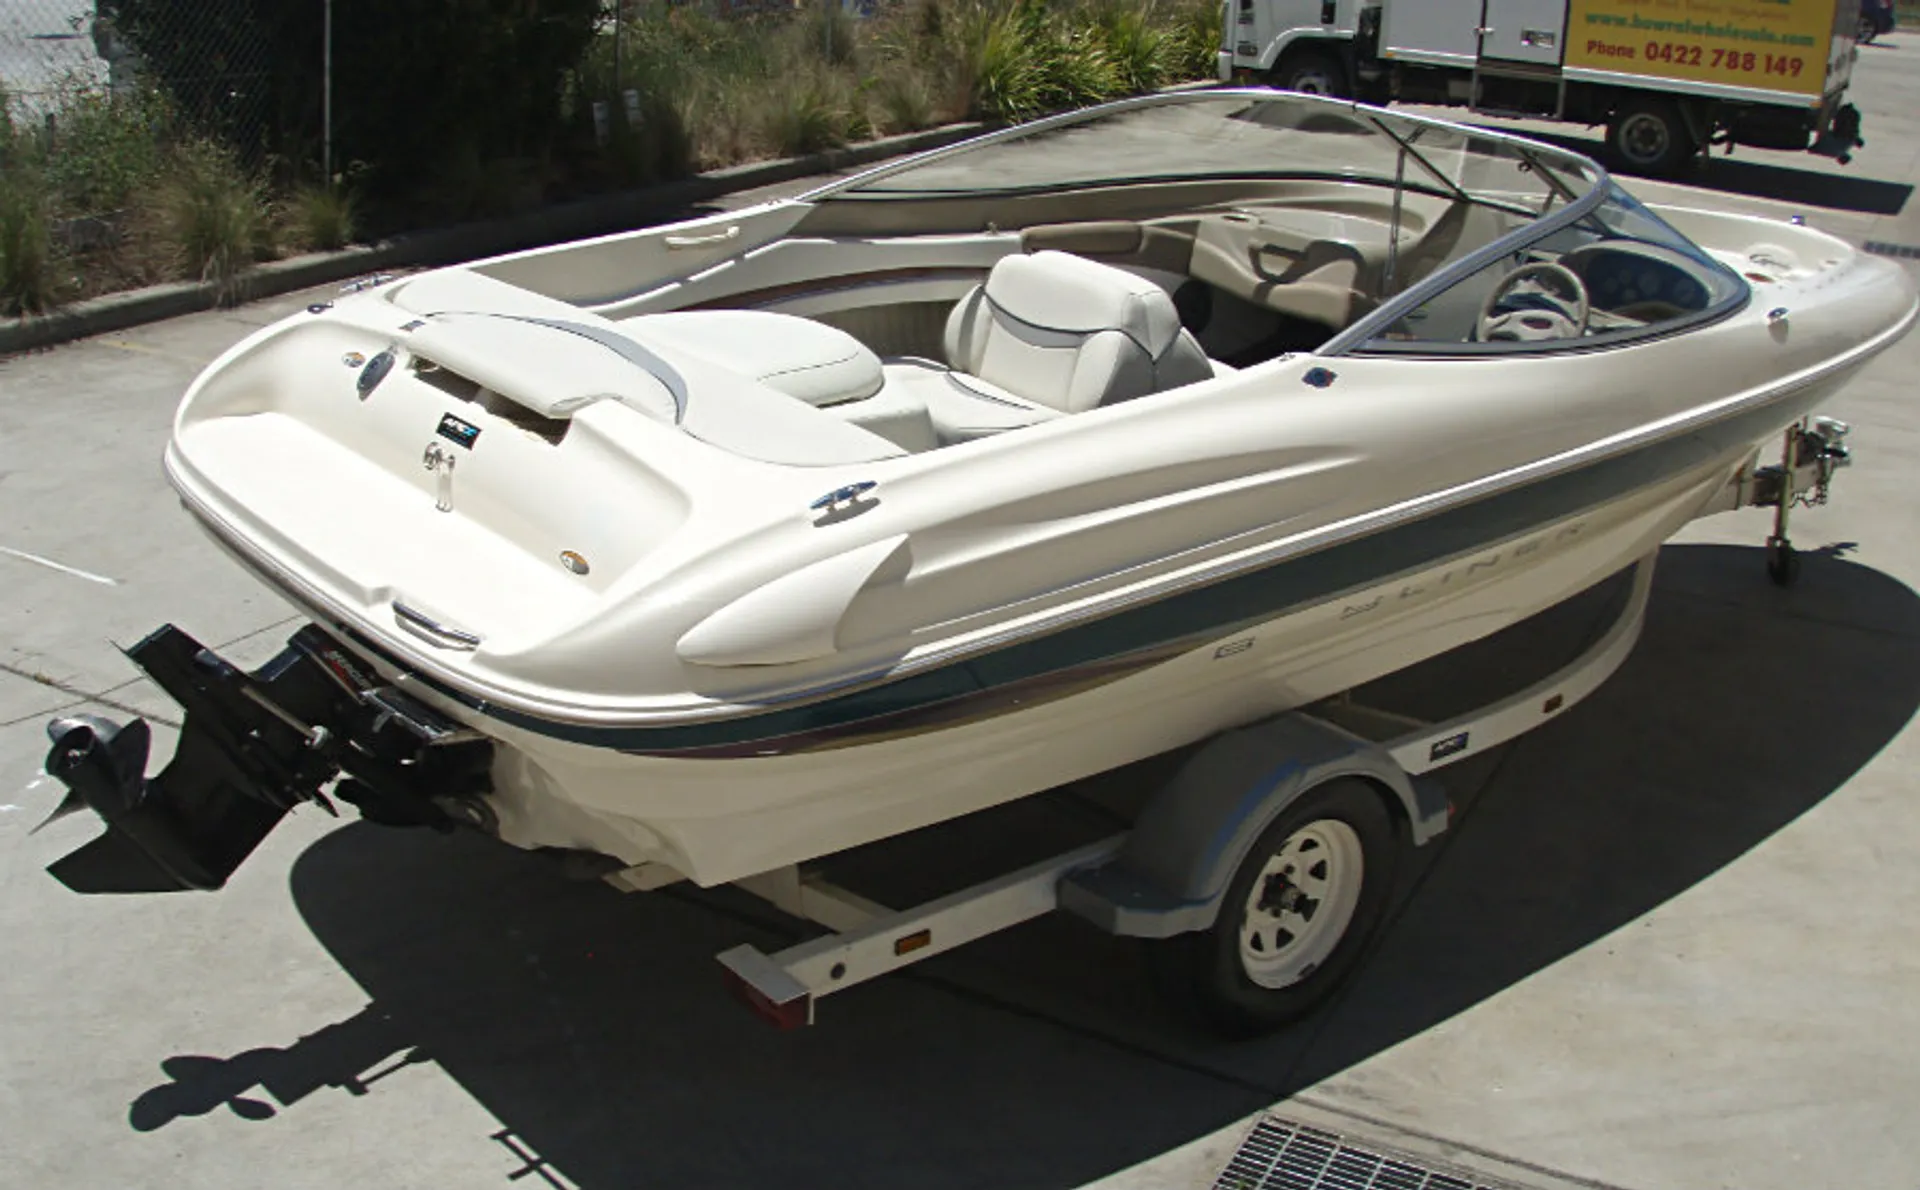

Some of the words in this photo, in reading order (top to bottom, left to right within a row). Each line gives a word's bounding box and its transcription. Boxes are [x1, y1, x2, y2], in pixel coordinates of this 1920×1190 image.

[1587, 40, 1635, 59] Phone
[1645, 41, 1703, 66] 0422
[1710, 48, 1756, 72] 788
[1764, 53, 1804, 77] 149
